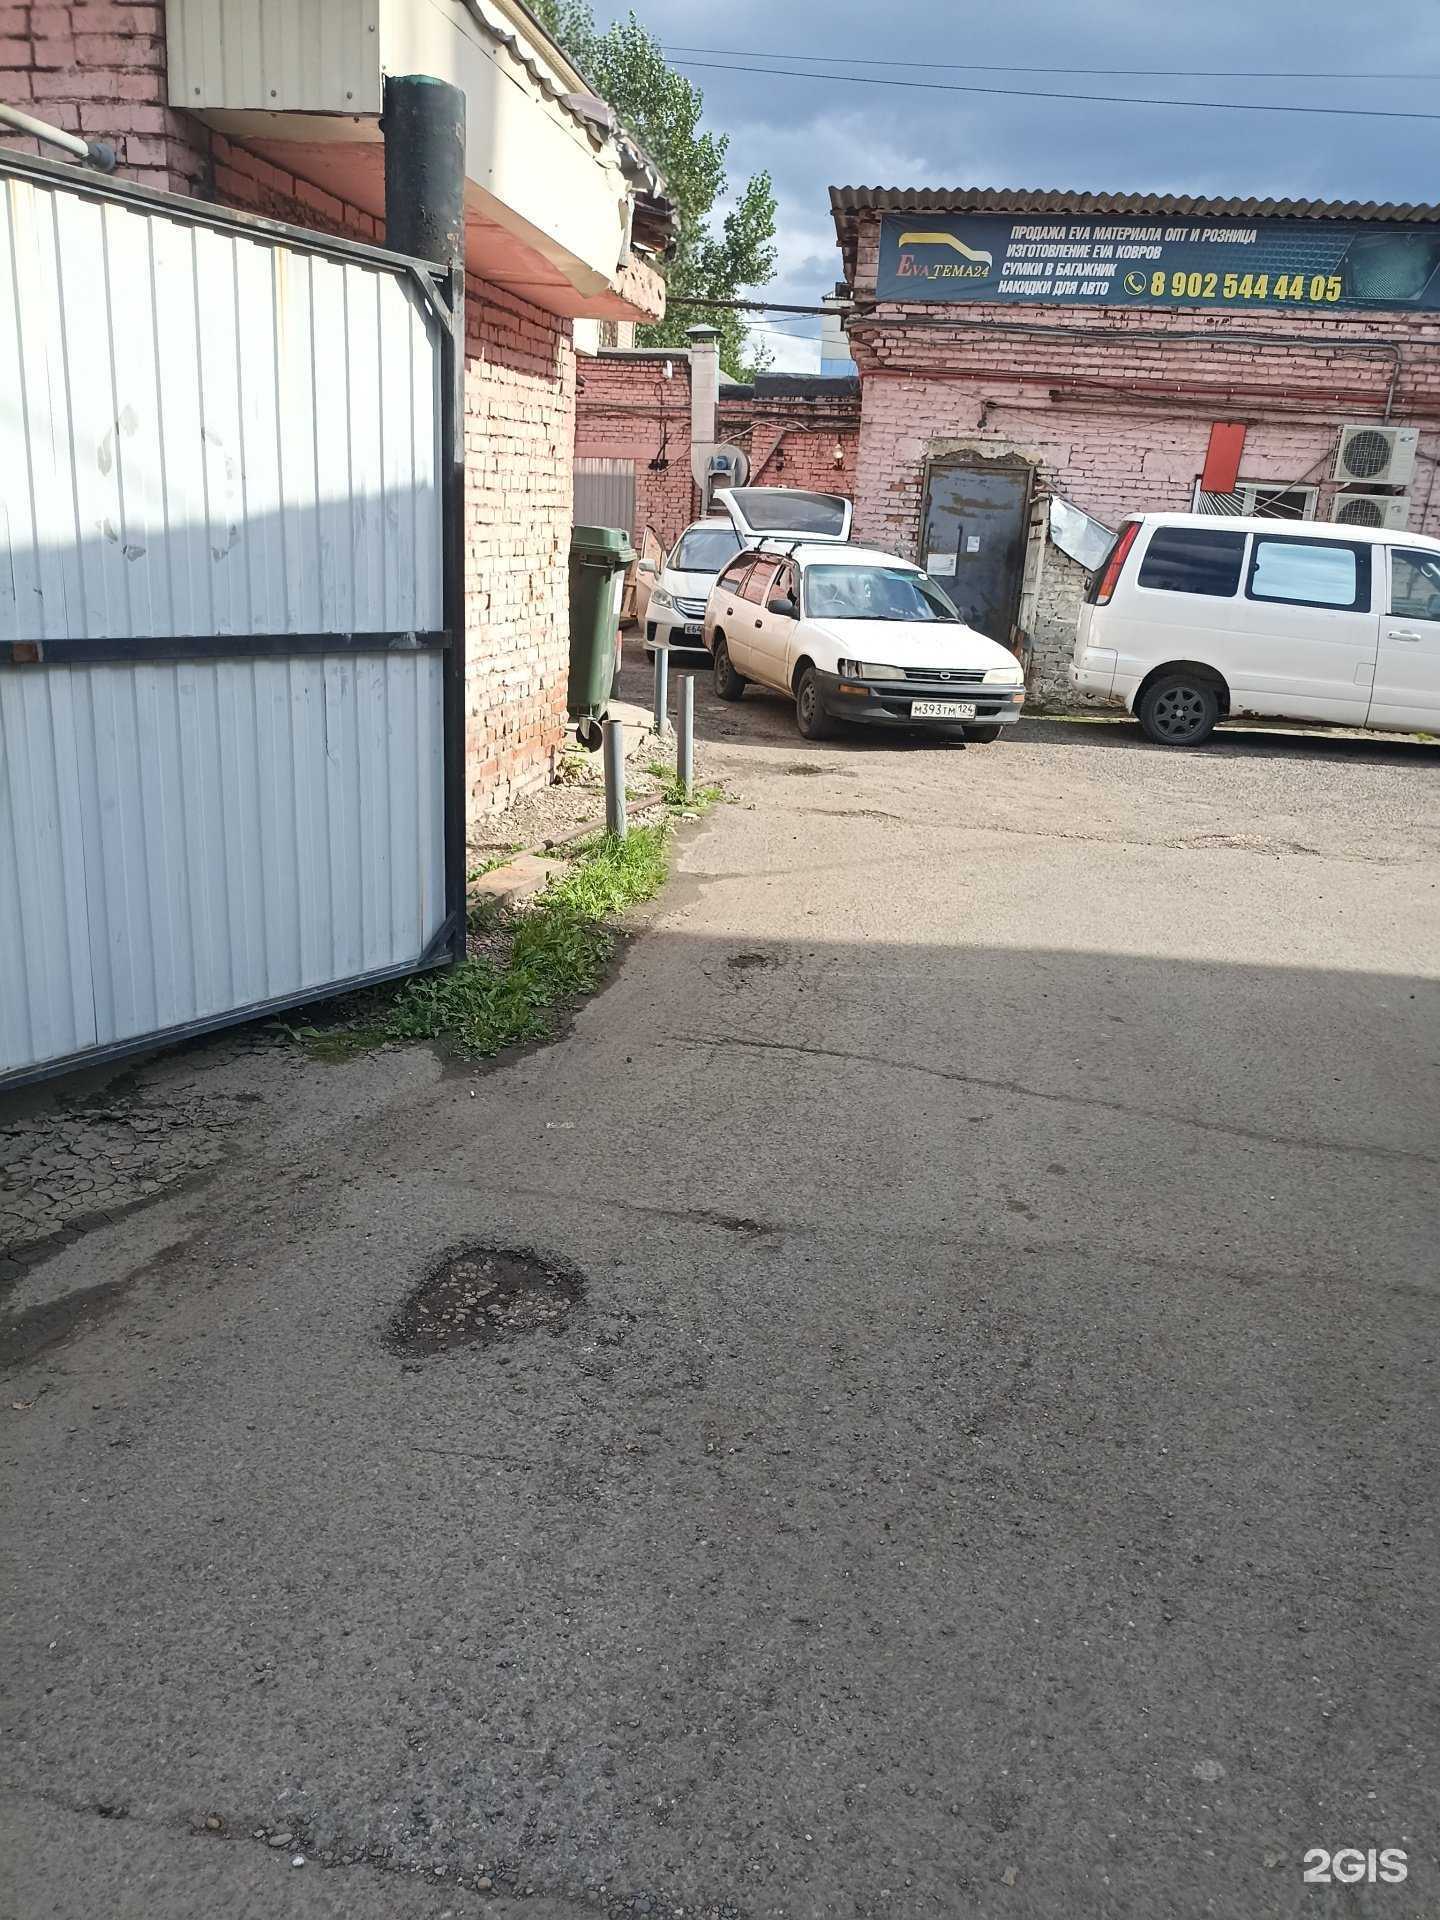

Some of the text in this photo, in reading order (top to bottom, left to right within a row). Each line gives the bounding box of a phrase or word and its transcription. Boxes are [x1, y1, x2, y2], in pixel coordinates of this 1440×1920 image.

[1011, 226, 1257, 244] ПРОДАЖА EVA МАТЕРИАЛА ОПТ И РОЗНИЦА
[1006, 244, 1162, 259] ИЗГОТОВЛЕНИЕ EVA КОВРОВ
[1001, 262, 1118, 277] СУМКИ В БАГАЖНИК
[998, 280, 1110, 296] НАКИДКИ ДЛЯ АВТО
[1150, 271, 1342, 302] 8 902 544 44 05
